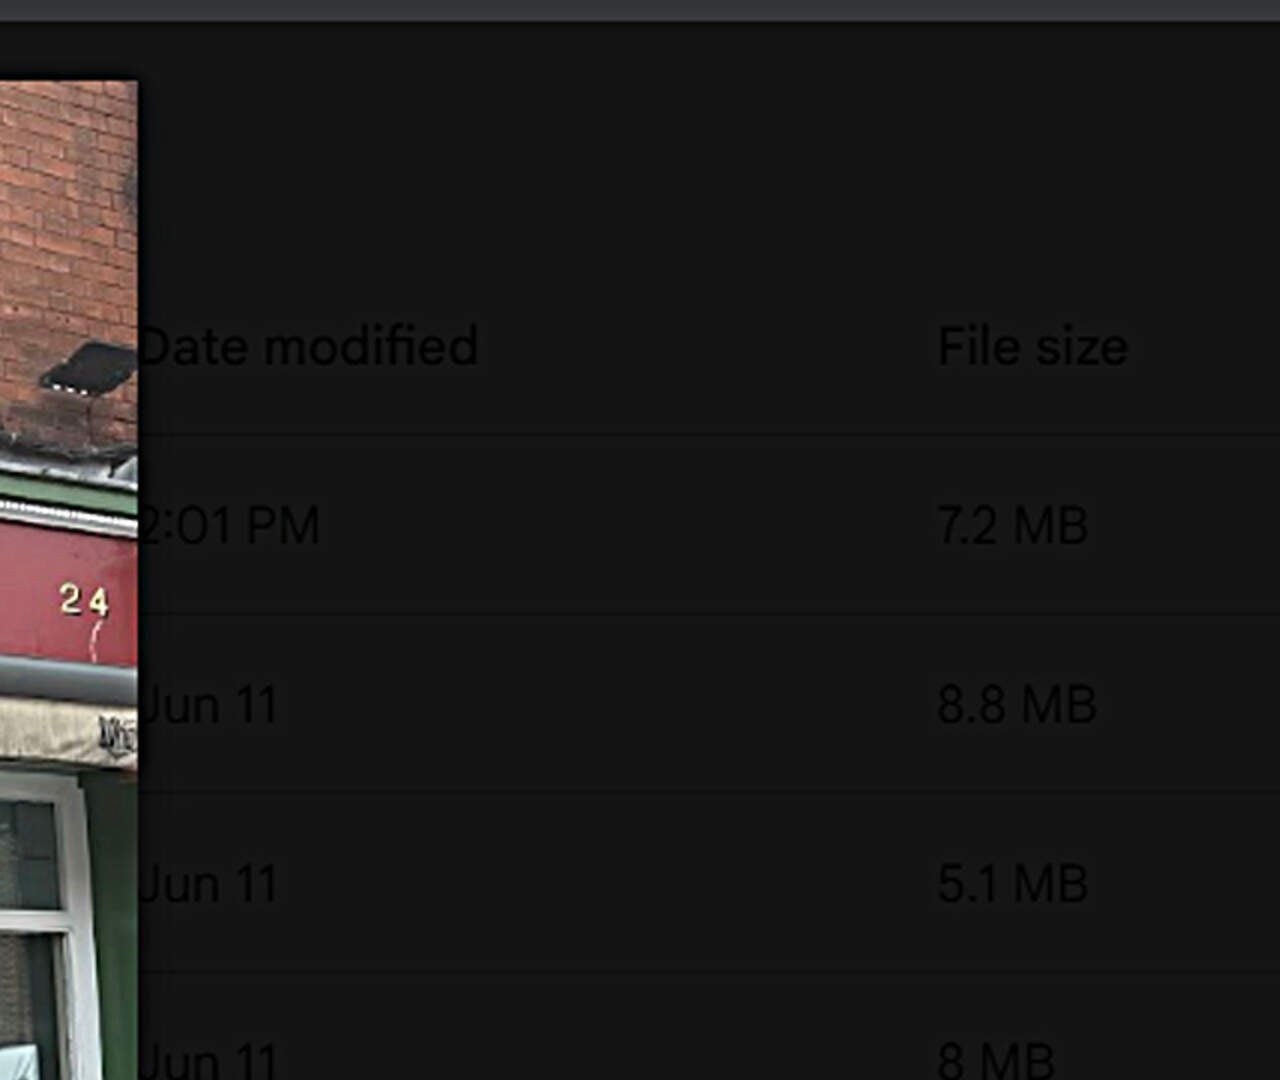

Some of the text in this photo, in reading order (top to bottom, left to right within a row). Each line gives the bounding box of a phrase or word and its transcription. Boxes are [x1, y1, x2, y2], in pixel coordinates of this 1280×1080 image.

[140, 323, 477, 365] Date modified
[941, 323, 1128, 365] File size
[249, 505, 318, 544] PM
[939, 504, 1088, 544] 7.2 MB
[59, 582, 109, 617] 24
[141, 684, 273, 723] Jun 11
[938, 684, 1096, 723] 8.8 MB
[141, 863, 273, 902] Jun 11
[940, 863, 1087, 902] 5.1 MB
[141, 1042, 273, 1080] Jun 11
[982, 1042, 1054, 1080] MB
